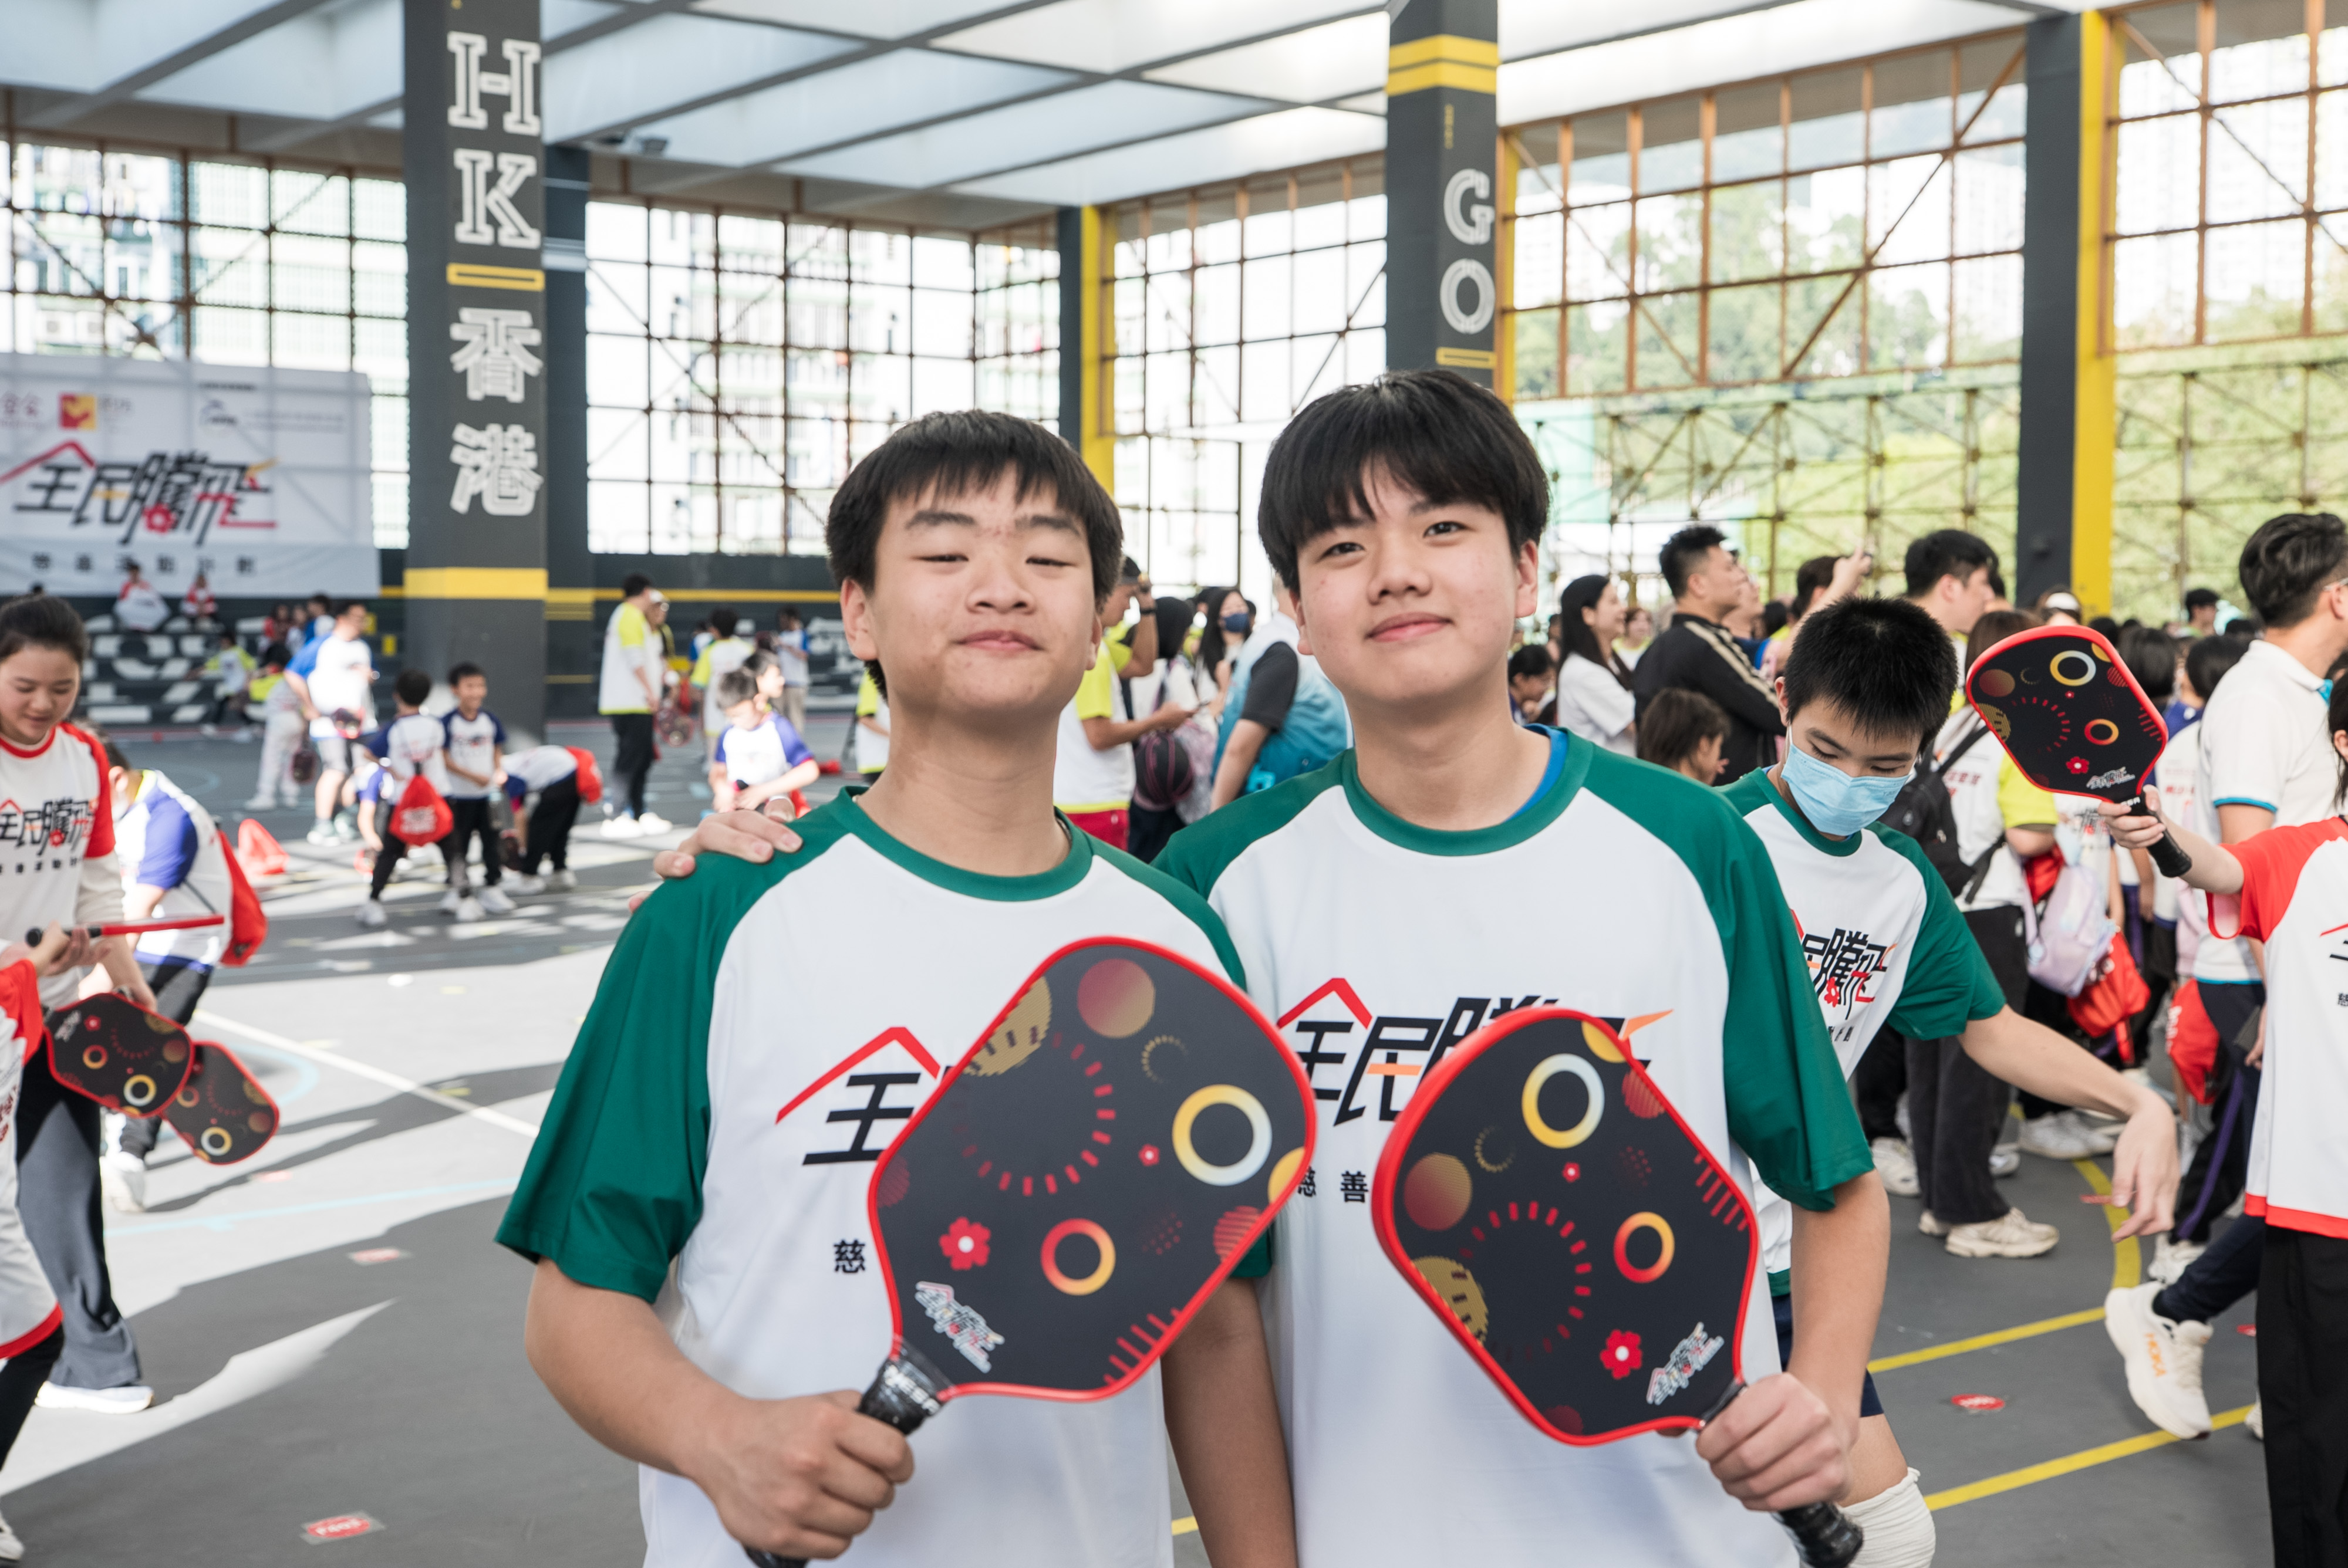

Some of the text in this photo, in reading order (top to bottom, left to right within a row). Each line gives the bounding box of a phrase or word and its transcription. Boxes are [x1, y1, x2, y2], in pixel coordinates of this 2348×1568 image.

[447, 31, 541, 248] HK
[1439, 168, 1496, 334] GO
[450, 307, 544, 516] 香港
[834, 1239, 865, 1273] 慈
